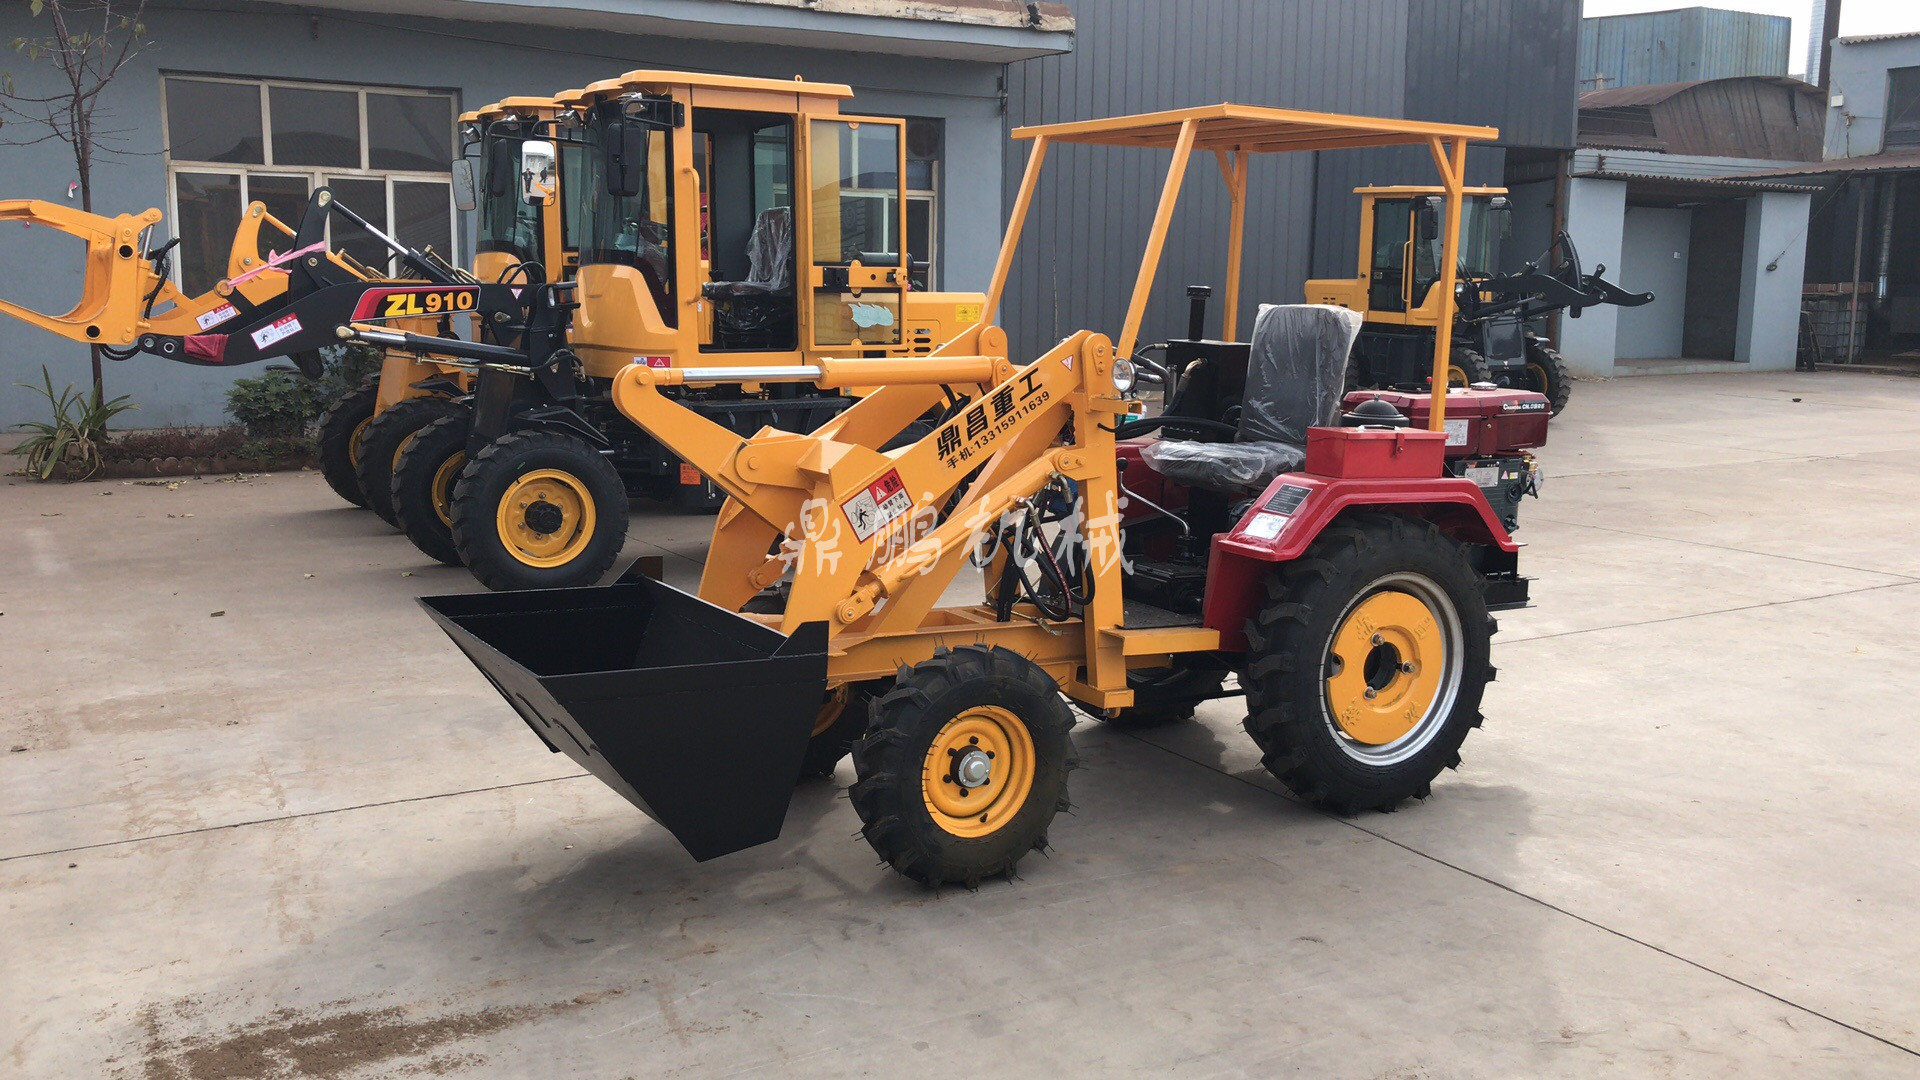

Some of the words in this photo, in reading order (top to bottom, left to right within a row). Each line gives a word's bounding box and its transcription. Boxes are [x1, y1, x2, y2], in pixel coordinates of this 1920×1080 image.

[384, 291, 473, 317] ZL910
[937, 367, 1042, 461] 鼎昌重工
[884, 476, 899, 492] 危险
